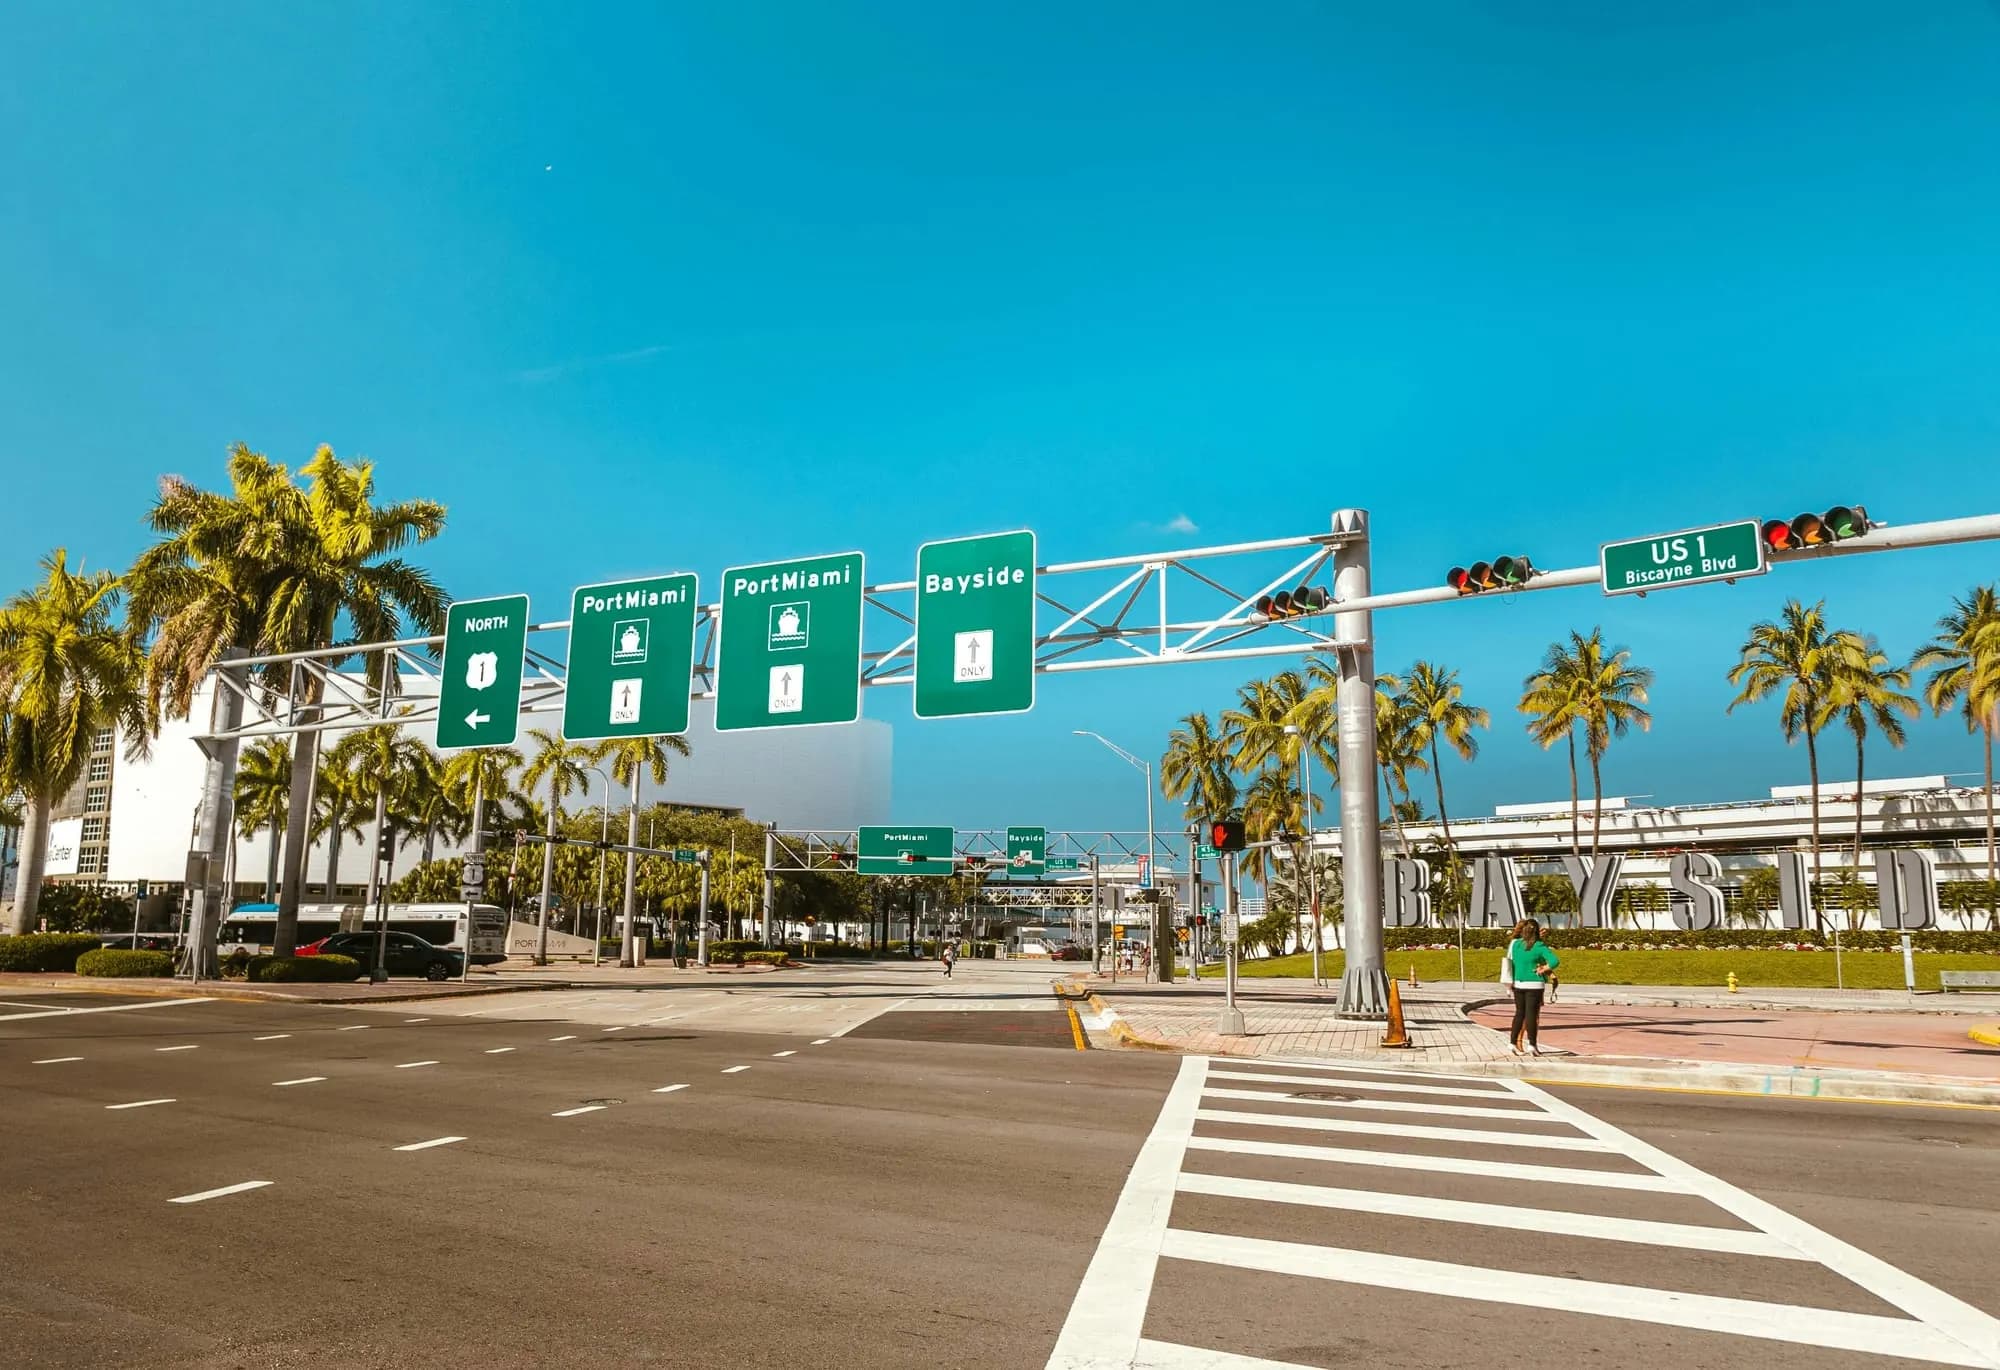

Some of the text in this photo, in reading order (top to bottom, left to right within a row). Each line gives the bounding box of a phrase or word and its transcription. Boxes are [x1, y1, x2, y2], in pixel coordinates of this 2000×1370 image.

[1651, 535, 1706, 564] US 1
[1625, 554, 1737, 584] Biscayne Blvd
[734, 564, 850, 597] PortMiami
[925, 565, 1025, 594] Bayside
[582, 584, 686, 614] PortMiami
[465, 615, 509, 633] NORTH
[479, 661, 485, 682] 1
[960, 666, 986, 677] ONLY
[774, 698, 797, 708] ONLY
[615, 710, 634, 720] ONLY
[884, 833, 928, 841] PortMiami
[1009, 834, 1043, 843] Bayside
